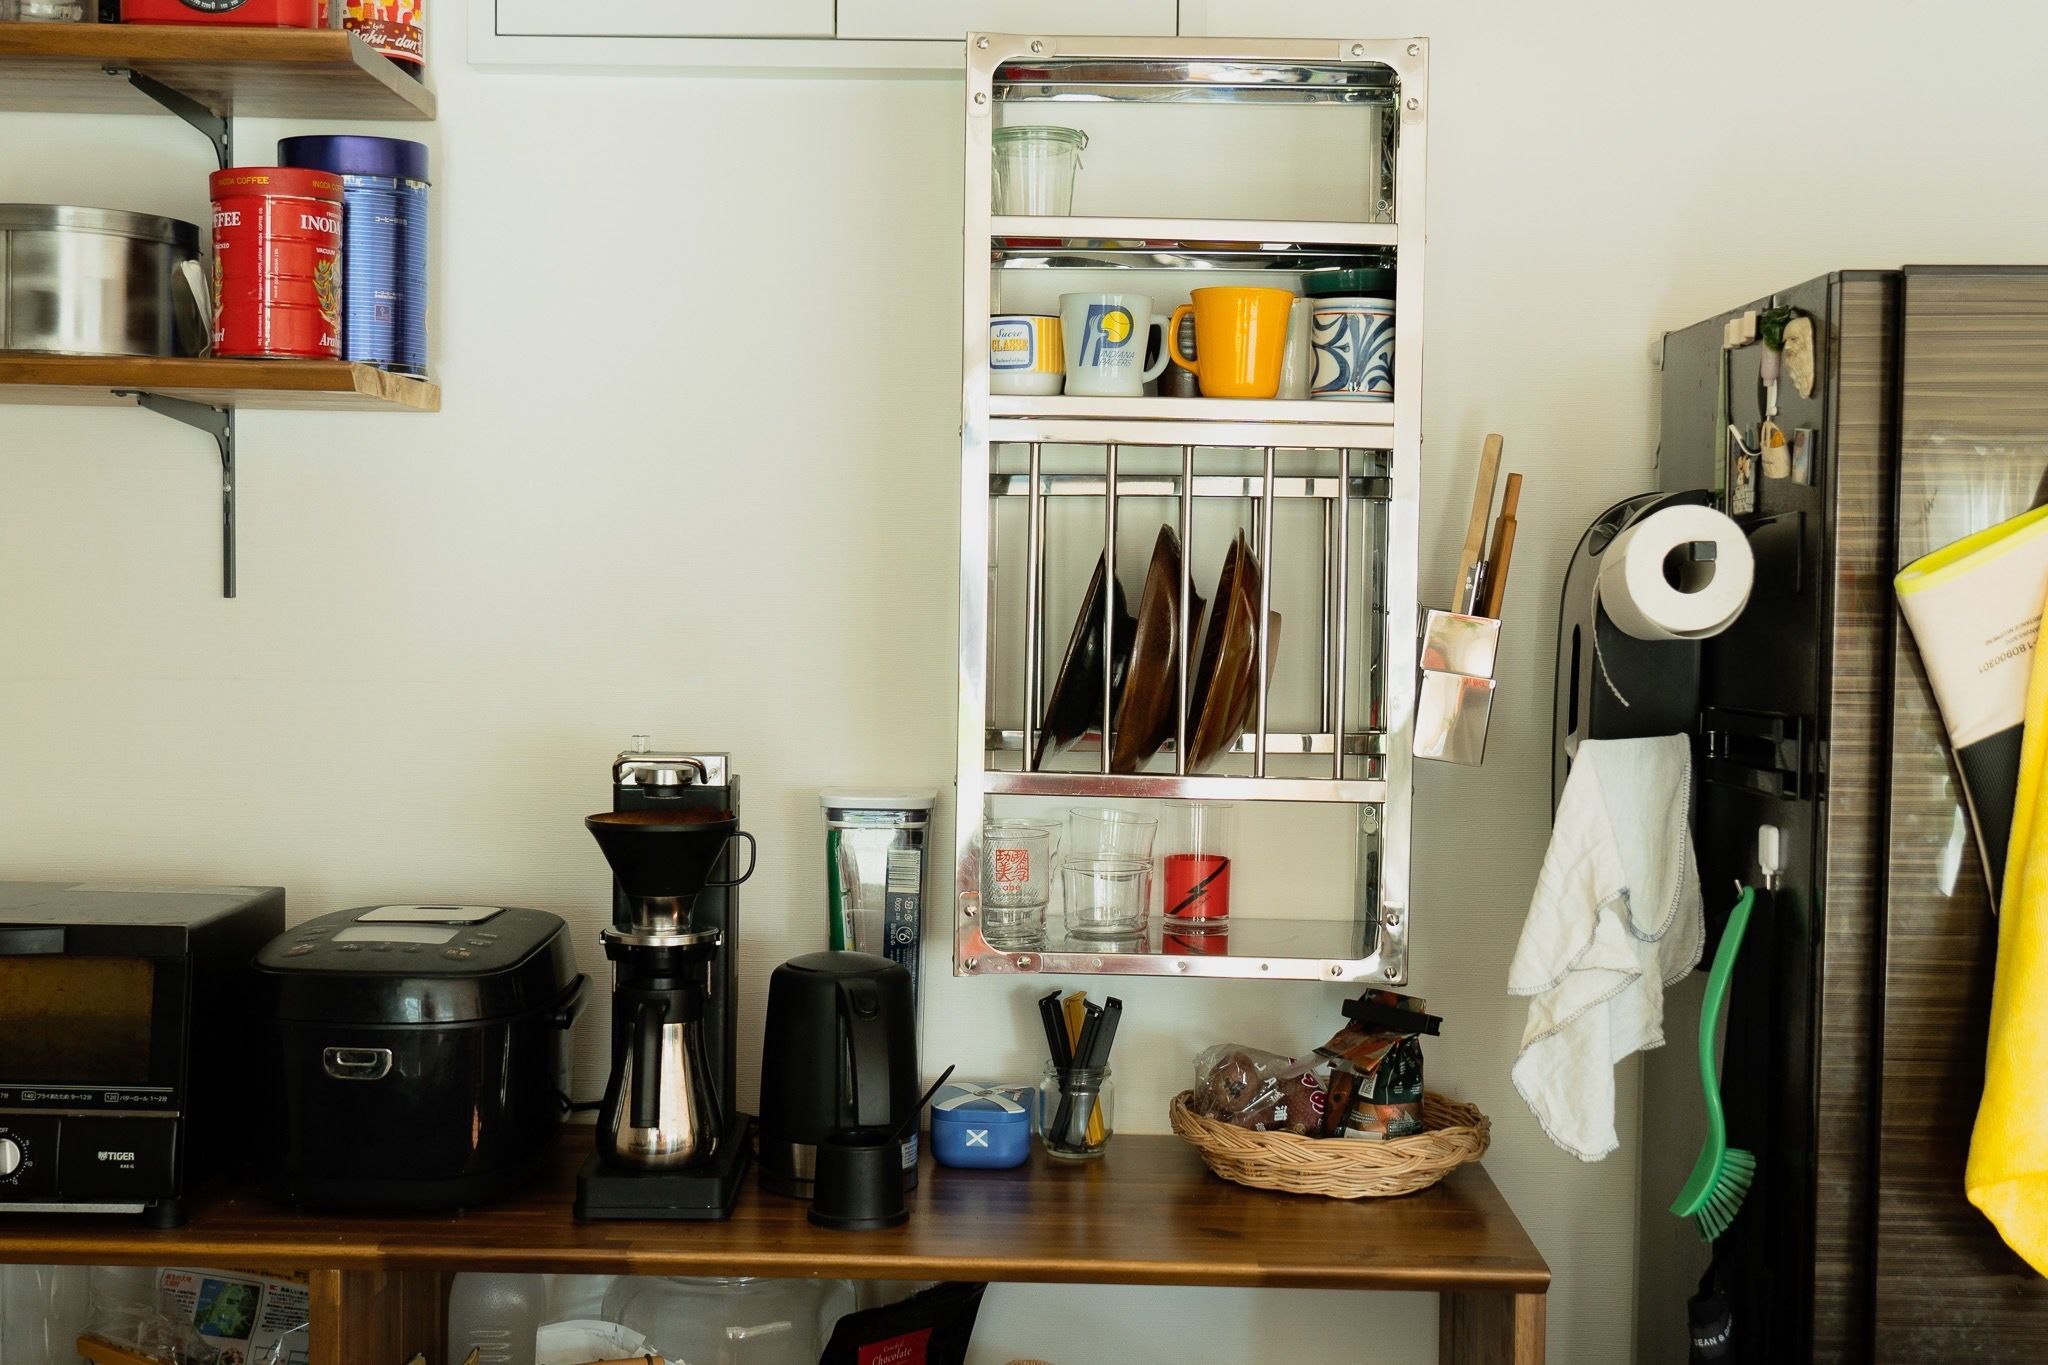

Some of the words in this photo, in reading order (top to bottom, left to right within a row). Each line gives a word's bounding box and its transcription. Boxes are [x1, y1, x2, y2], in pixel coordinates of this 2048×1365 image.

[237, 176, 270, 184] COFFEE
[312, 180, 331, 190] INODA
[1101, 350, 1136, 359] INDIANA
[1098, 358, 1133, 367] PACERS
[894, 897, 902, 912] 500g
[108, 1152, 135, 1161] TIGER
[872, 1347, 912, 1365] Chocolate
